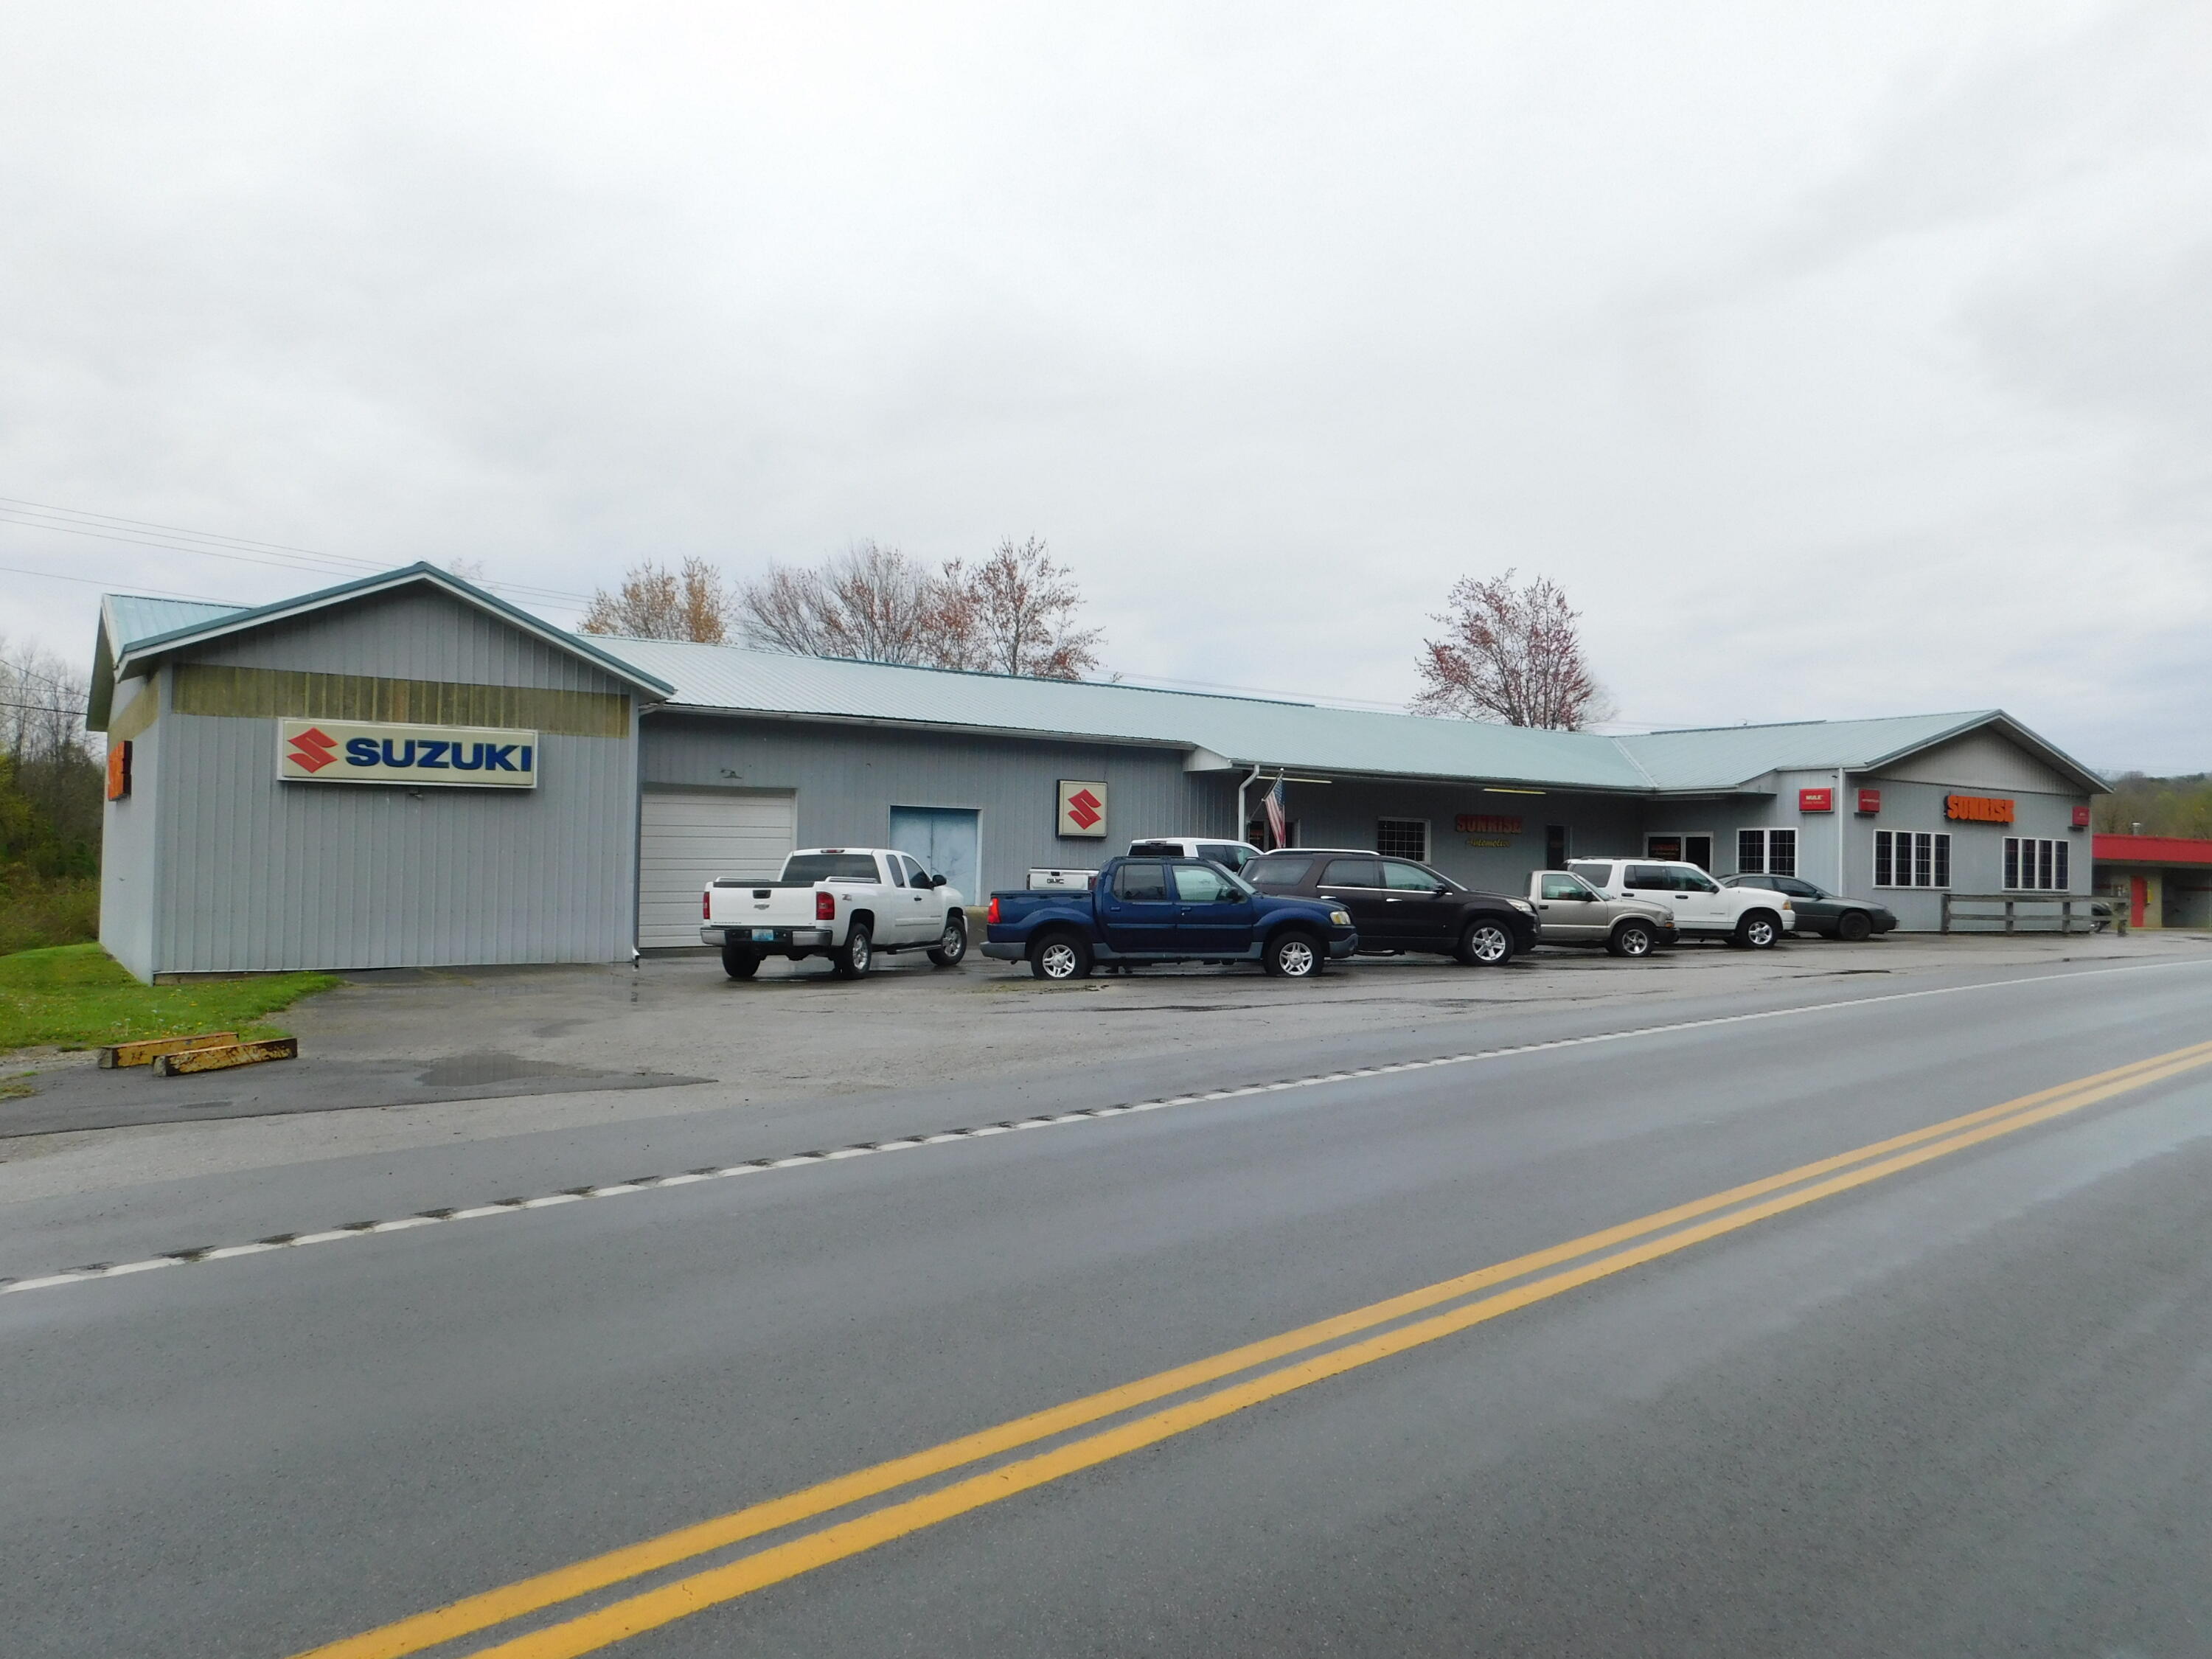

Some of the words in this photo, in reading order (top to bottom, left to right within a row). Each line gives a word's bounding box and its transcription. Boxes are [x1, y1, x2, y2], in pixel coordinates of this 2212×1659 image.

[344, 737, 533, 773] SUZUKI
[1947, 795, 2015, 823] SUNRISE
[1455, 814, 1523, 833] SUNRISE
